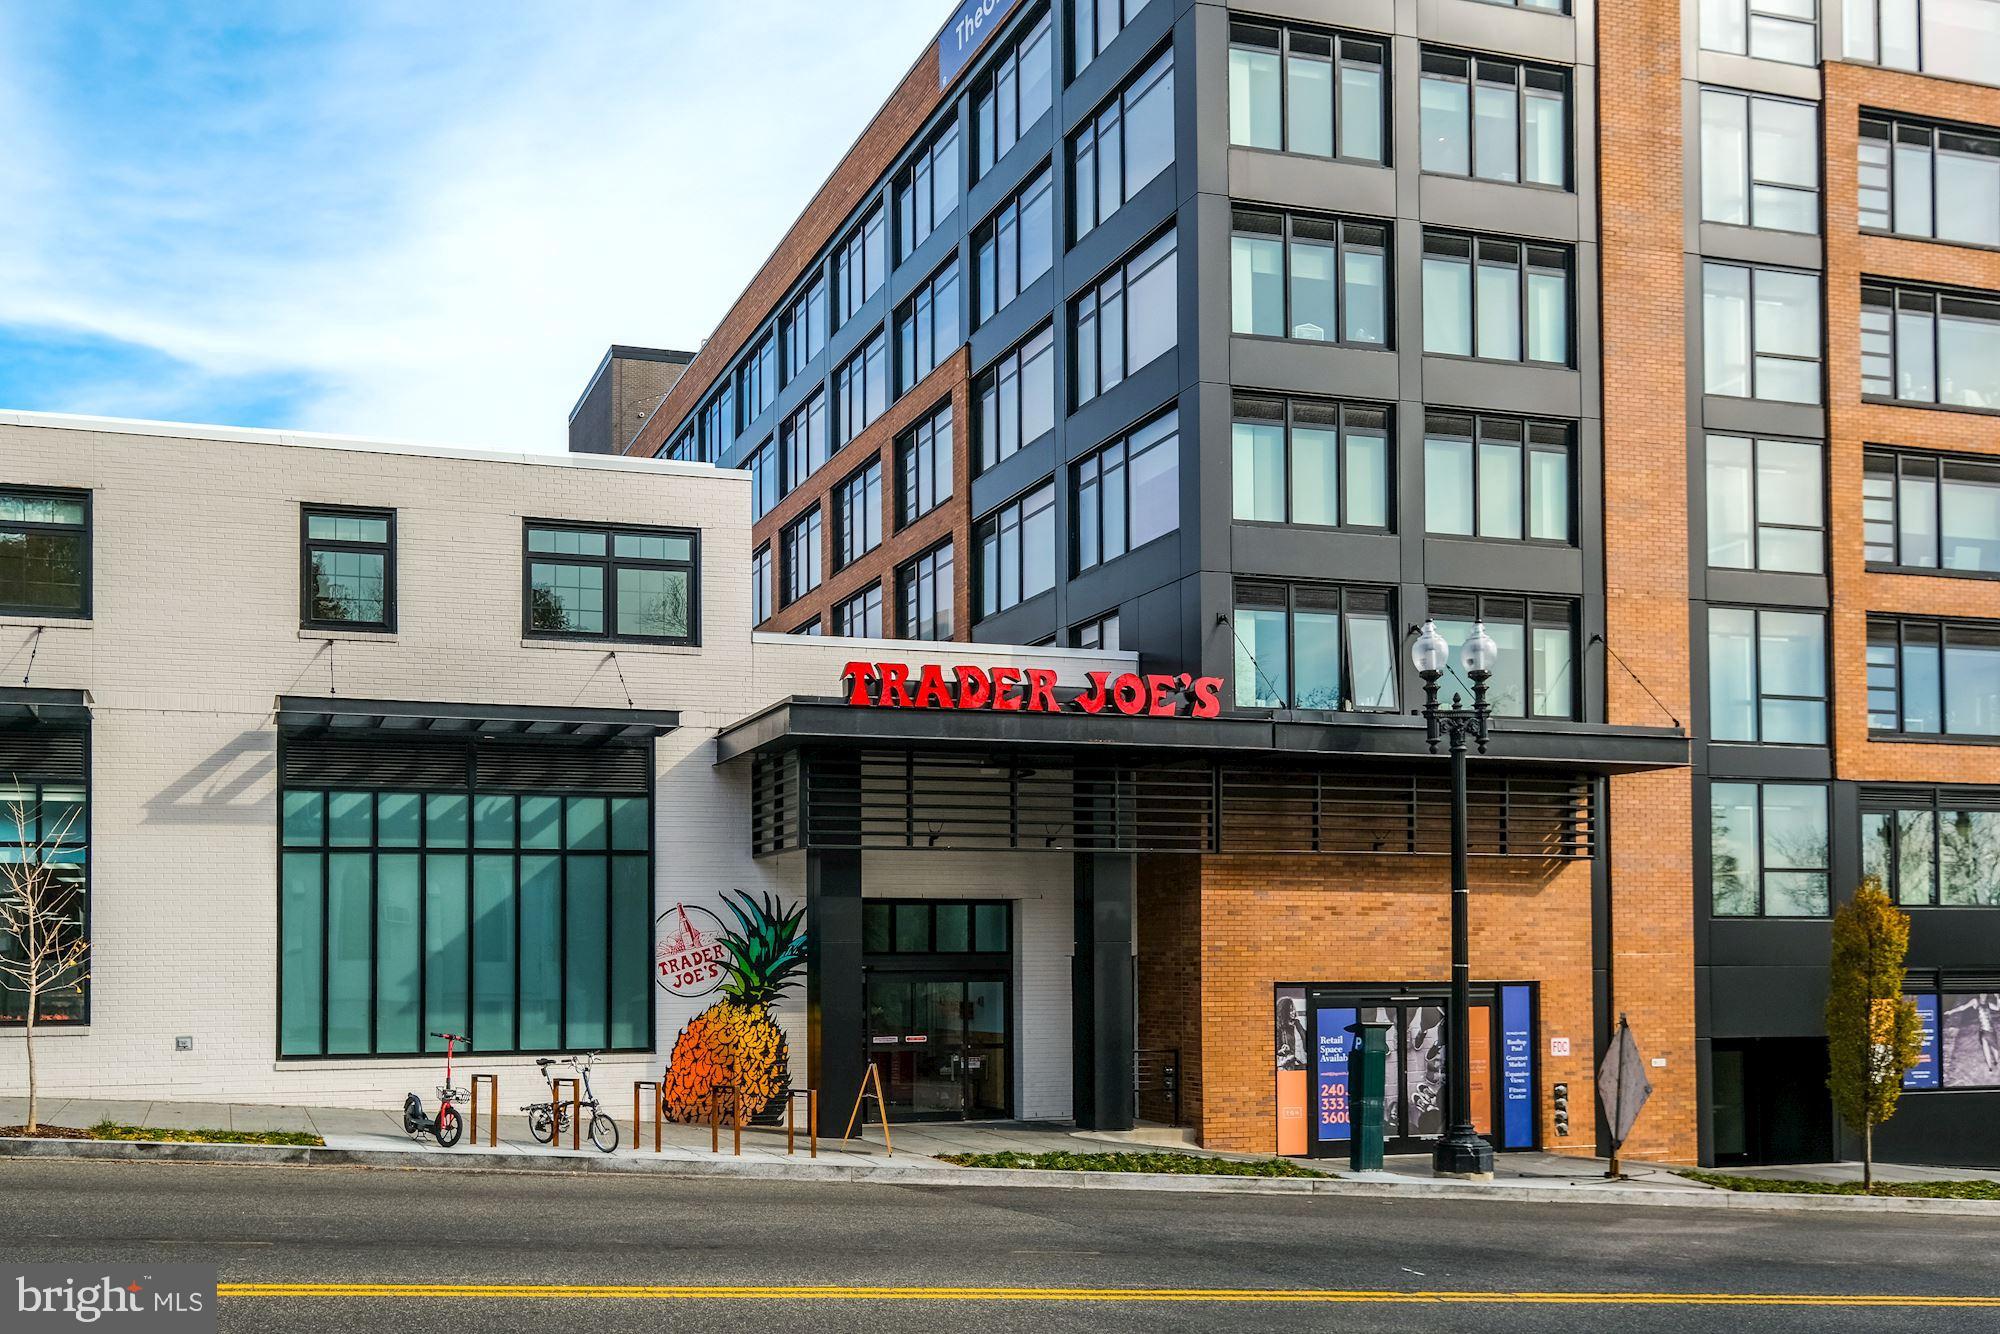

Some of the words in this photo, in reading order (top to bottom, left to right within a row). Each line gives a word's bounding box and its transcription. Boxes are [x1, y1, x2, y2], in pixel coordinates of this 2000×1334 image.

[955, 0, 999, 50] The
[840, 661, 1062, 712] TRADER
[1075, 671, 1225, 719] JOE'S
[658, 944, 725, 976] TRADER
[673, 963, 719, 989] JOE'S
[1320, 1036, 1343, 1045] Retail
[1320, 1045, 1343, 1055] Space
[1355, 1037, 1362, 1049] P
[1320, 1053, 1348, 1062] Availab
